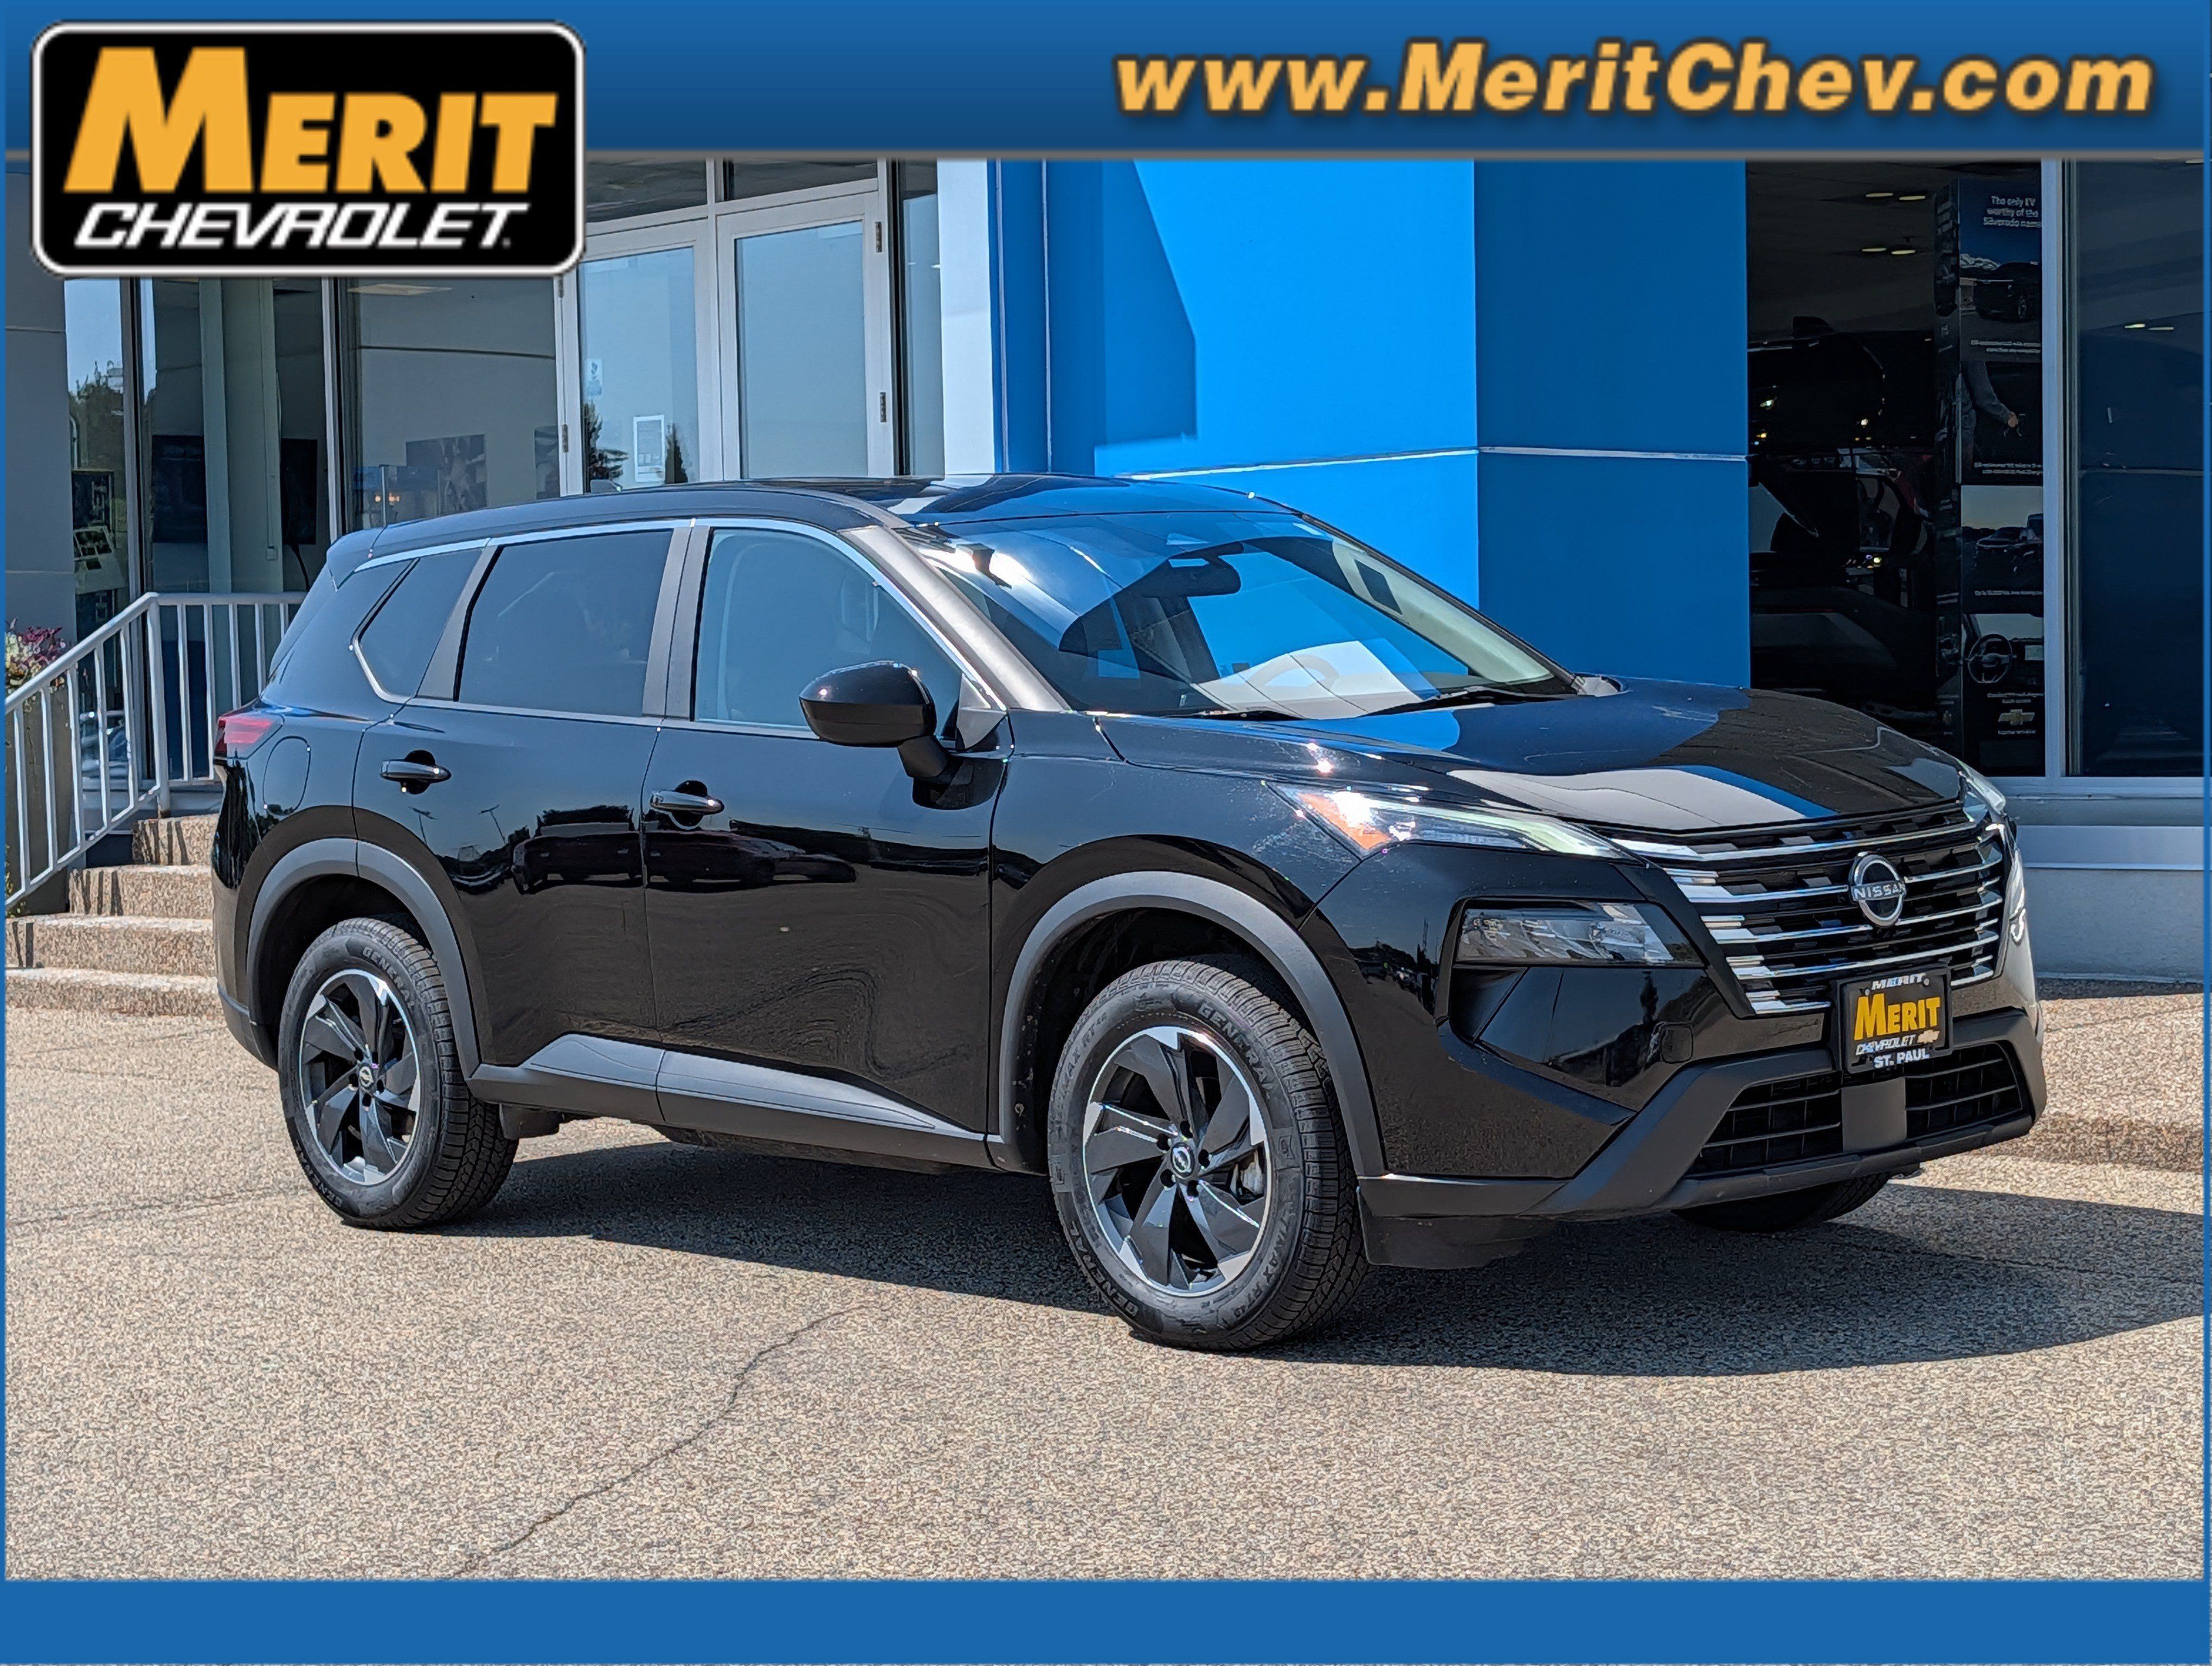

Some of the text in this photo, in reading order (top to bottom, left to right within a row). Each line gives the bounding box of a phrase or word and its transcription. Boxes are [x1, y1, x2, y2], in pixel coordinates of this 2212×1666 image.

[1853, 881, 1906, 899] NISSAN
[1872, 972, 1926, 990] MERIT
[1198, 1003, 1274, 1100] GENERAL
[1874, 1048, 1930, 1068] ST. PAUL
[1070, 1220, 1139, 1316] GENERAL
